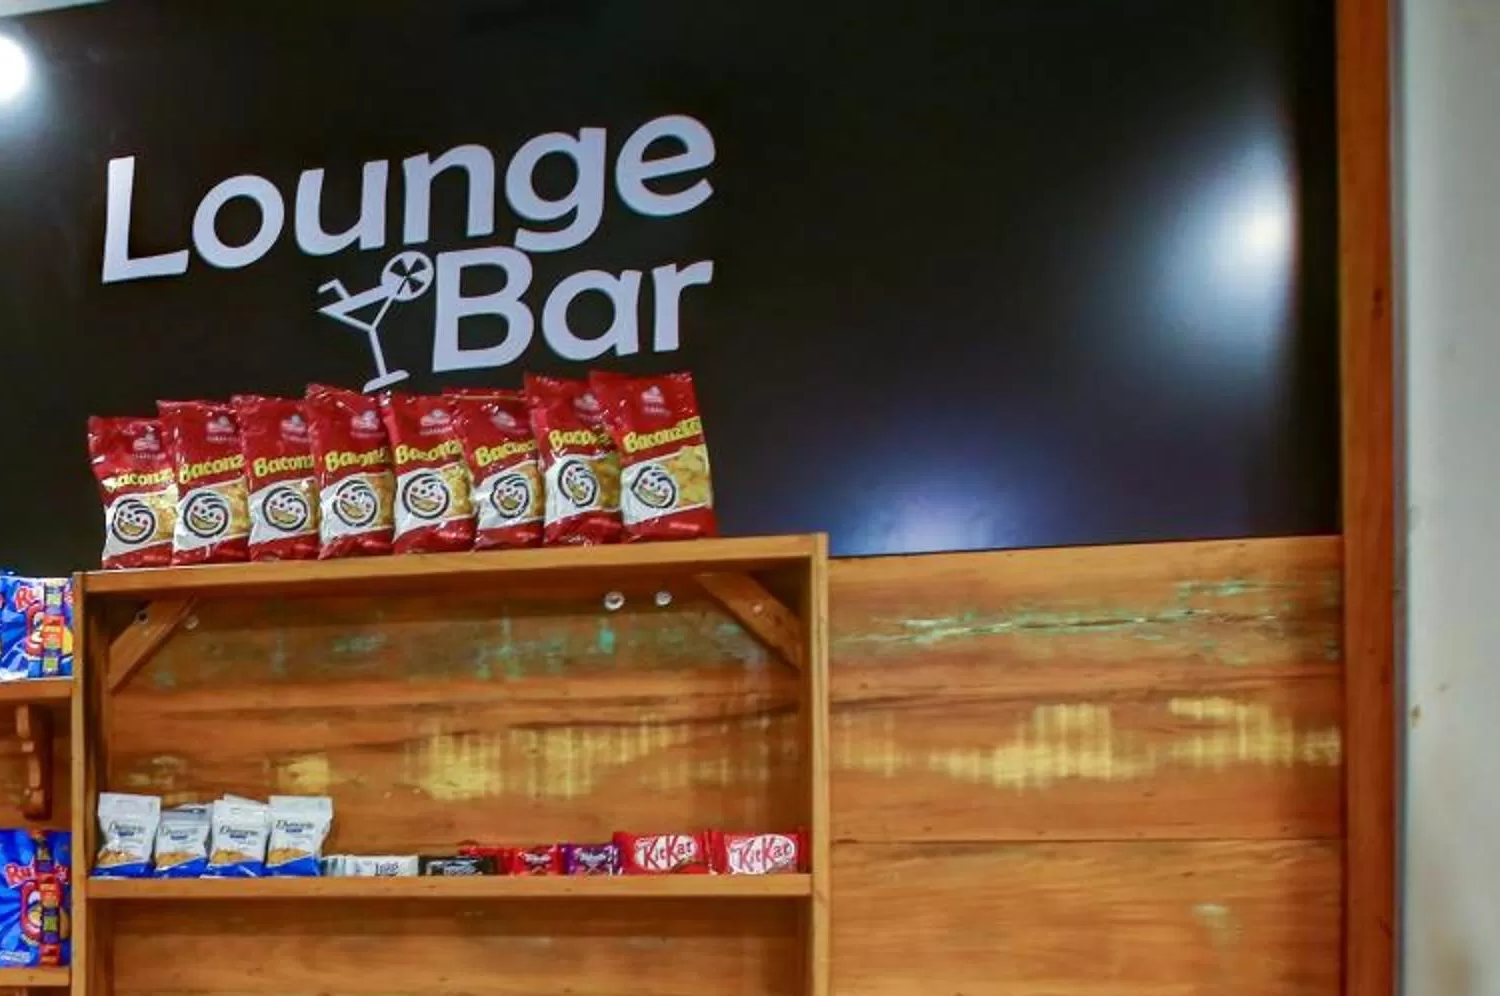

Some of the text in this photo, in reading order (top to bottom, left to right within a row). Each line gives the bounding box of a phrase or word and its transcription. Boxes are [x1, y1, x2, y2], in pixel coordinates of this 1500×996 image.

[102, 114, 716, 283] Lounge
[432, 245, 714, 373] Bar
[180, 453, 245, 485] Baconz
